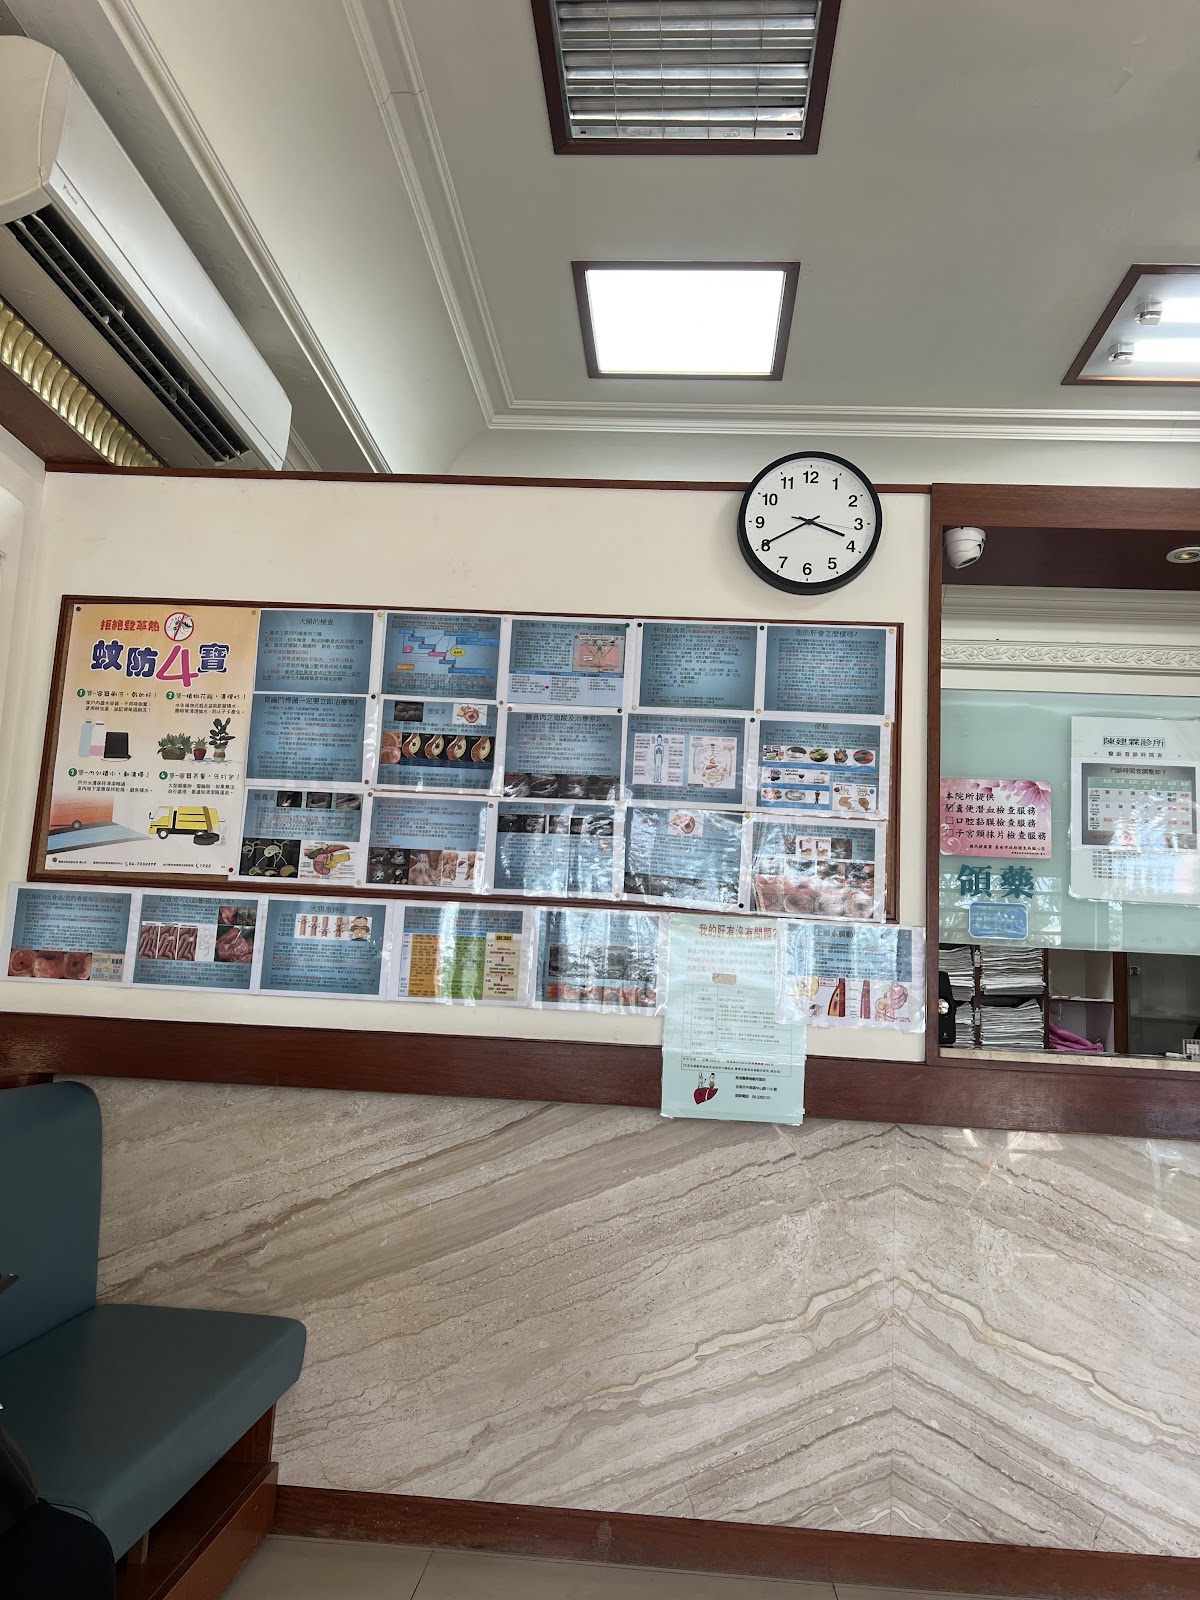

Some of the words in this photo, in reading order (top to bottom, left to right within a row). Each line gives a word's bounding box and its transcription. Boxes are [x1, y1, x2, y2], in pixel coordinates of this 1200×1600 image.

[780, 476, 793, 489] 11
[803, 471, 819, 484] 12
[832, 477, 838, 490] 1
[762, 493, 778, 506] 10
[848, 495, 858, 507] 2
[755, 516, 765, 529] 9
[854, 518, 864, 530] 3
[761, 539, 771, 552] 8
[846, 540, 856, 553] 4
[778, 556, 788, 569] 7
[802, 562, 812, 575] 6
[827, 557, 837, 570] 5
[100, 619, 160, 632] 拒絕登革熱
[299, 618, 334, 626] 大腸的檢查
[90, 639, 230, 688] 蚊防4寶
[945, 792, 995, 801] 本院所提供
[955, 804, 1037, 816] 糞便潛血檢查服務
[955, 817, 1037, 828] 口腔黏膜檢查服務
[955, 829, 1048, 841] 子宮頸抹片檢查服務
[957, 864, 1035, 899] 領藥
[698, 923, 778, 941] 我的肝有沒有問題?
